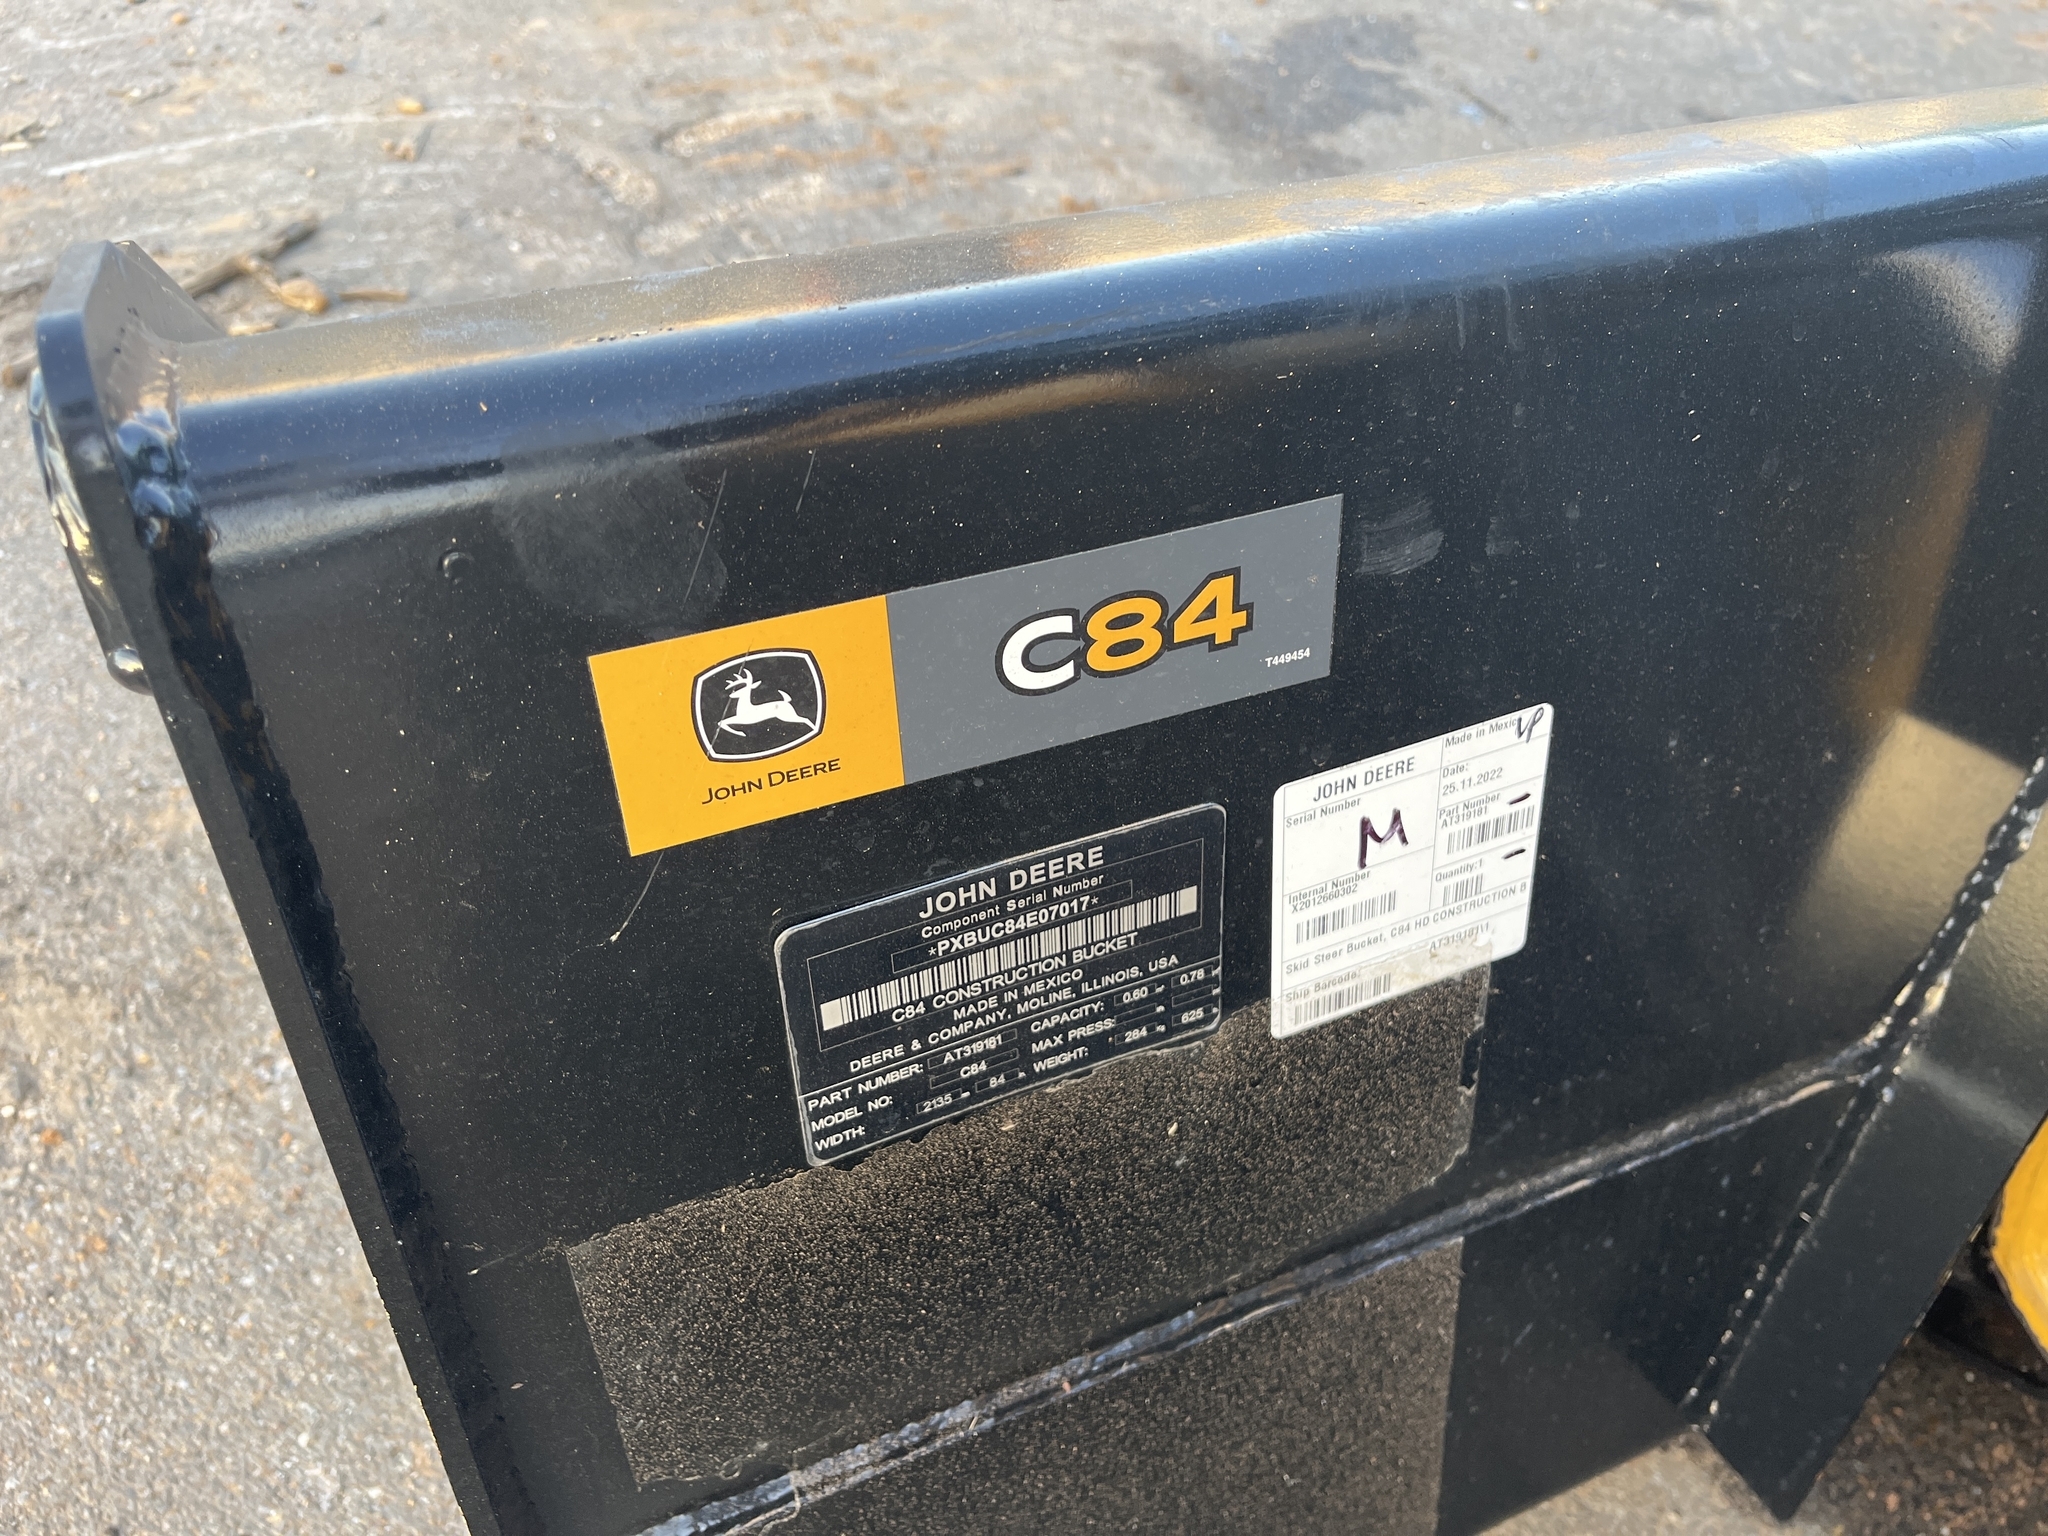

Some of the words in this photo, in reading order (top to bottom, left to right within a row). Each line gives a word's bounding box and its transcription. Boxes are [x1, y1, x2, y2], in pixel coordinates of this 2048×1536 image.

[995, 566, 1254, 696] C84
[1265, 647, 1311, 668] T449454
[1445, 732, 1472, 748] Made
[1476, 727, 1485, 739] in
[1488, 718, 1519, 734] Mexic
[702, 778, 763, 805] JOHN
[767, 758, 841, 787] DEERE
[1313, 775, 1357, 802] JOHN
[1364, 756, 1415, 786] DEERE
[1442, 762, 1469, 779] Date:
[1442, 767, 1503, 796] 25.11.2022
[1286, 810, 1316, 828] Serial
[1320, 797, 1361, 818] Number
[1439, 806, 1459, 820] Part
[1463, 792, 1500, 811] Number
[1441, 805, 1488, 829] AT319181
[919, 878, 997, 919] JOHN
[1009, 845, 1104, 891] DEERE
[1288, 881, 1328, 905] Internal
[1331, 870, 1371, 889] Number
[1291, 883, 1358, 914] X2012660302
[921, 905, 1000, 939] Component
[1006, 890, 1047, 911] Serial
[1052, 874, 1104, 898] Number
[1286, 958, 1309, 976] Skid
[1314, 949, 1344, 966] Steer
[1346, 933, 1387, 954] Bucket,
[1390, 924, 1410, 939] C84
[1414, 916, 1430, 932] HD
[1432, 887, 1516, 926] CONSTRUCTION
[891, 1001, 926, 1023] C84
[932, 954, 1067, 1009] CONSTRUCTION
[1072, 932, 1138, 964] BUCKET
[953, 996, 998, 1021] MADE
[1004, 988, 1018, 1003] IN
[1024, 969, 1083, 996] MEXICO
[1030, 1000, 1105, 1033] CAPACITY:
[1122, 986, 1149, 1003] 0.60
[1180, 968, 1205, 985] 0.78
[1285, 985, 1311, 1004] Ship
[1314, 970, 1362, 993] Barcode:
[849, 1044, 905, 1073] DEERE
[911, 1039, 922, 1051] &
[928, 1008, 1012, 1044] COMPANY,
[1017, 987, 1076, 1015] MOLINE,
[1081, 966, 1144, 993] ILLINOIS,
[1148, 954, 1179, 972] USA
[1031, 1034, 1064, 1054] MAX
[1067, 1018, 1115, 1042] PRESS:
[1033, 1046, 1089, 1073] WEIGHT:
[1124, 1026, 1148, 1043] 284
[1181, 1007, 1204, 1024] 625
[808, 1087, 852, 1112] PART
[858, 1063, 924, 1094] NUMBER:
[943, 1034, 1003, 1065] AT319181
[811, 1106, 863, 1132] MODEL
[867, 1095, 893, 1112] NO:
[960, 1060, 988, 1079] C84
[815, 1125, 866, 1151] WIDTH:
[922, 1093, 953, 1112] 2135
[989, 1074, 1006, 1088] 84
